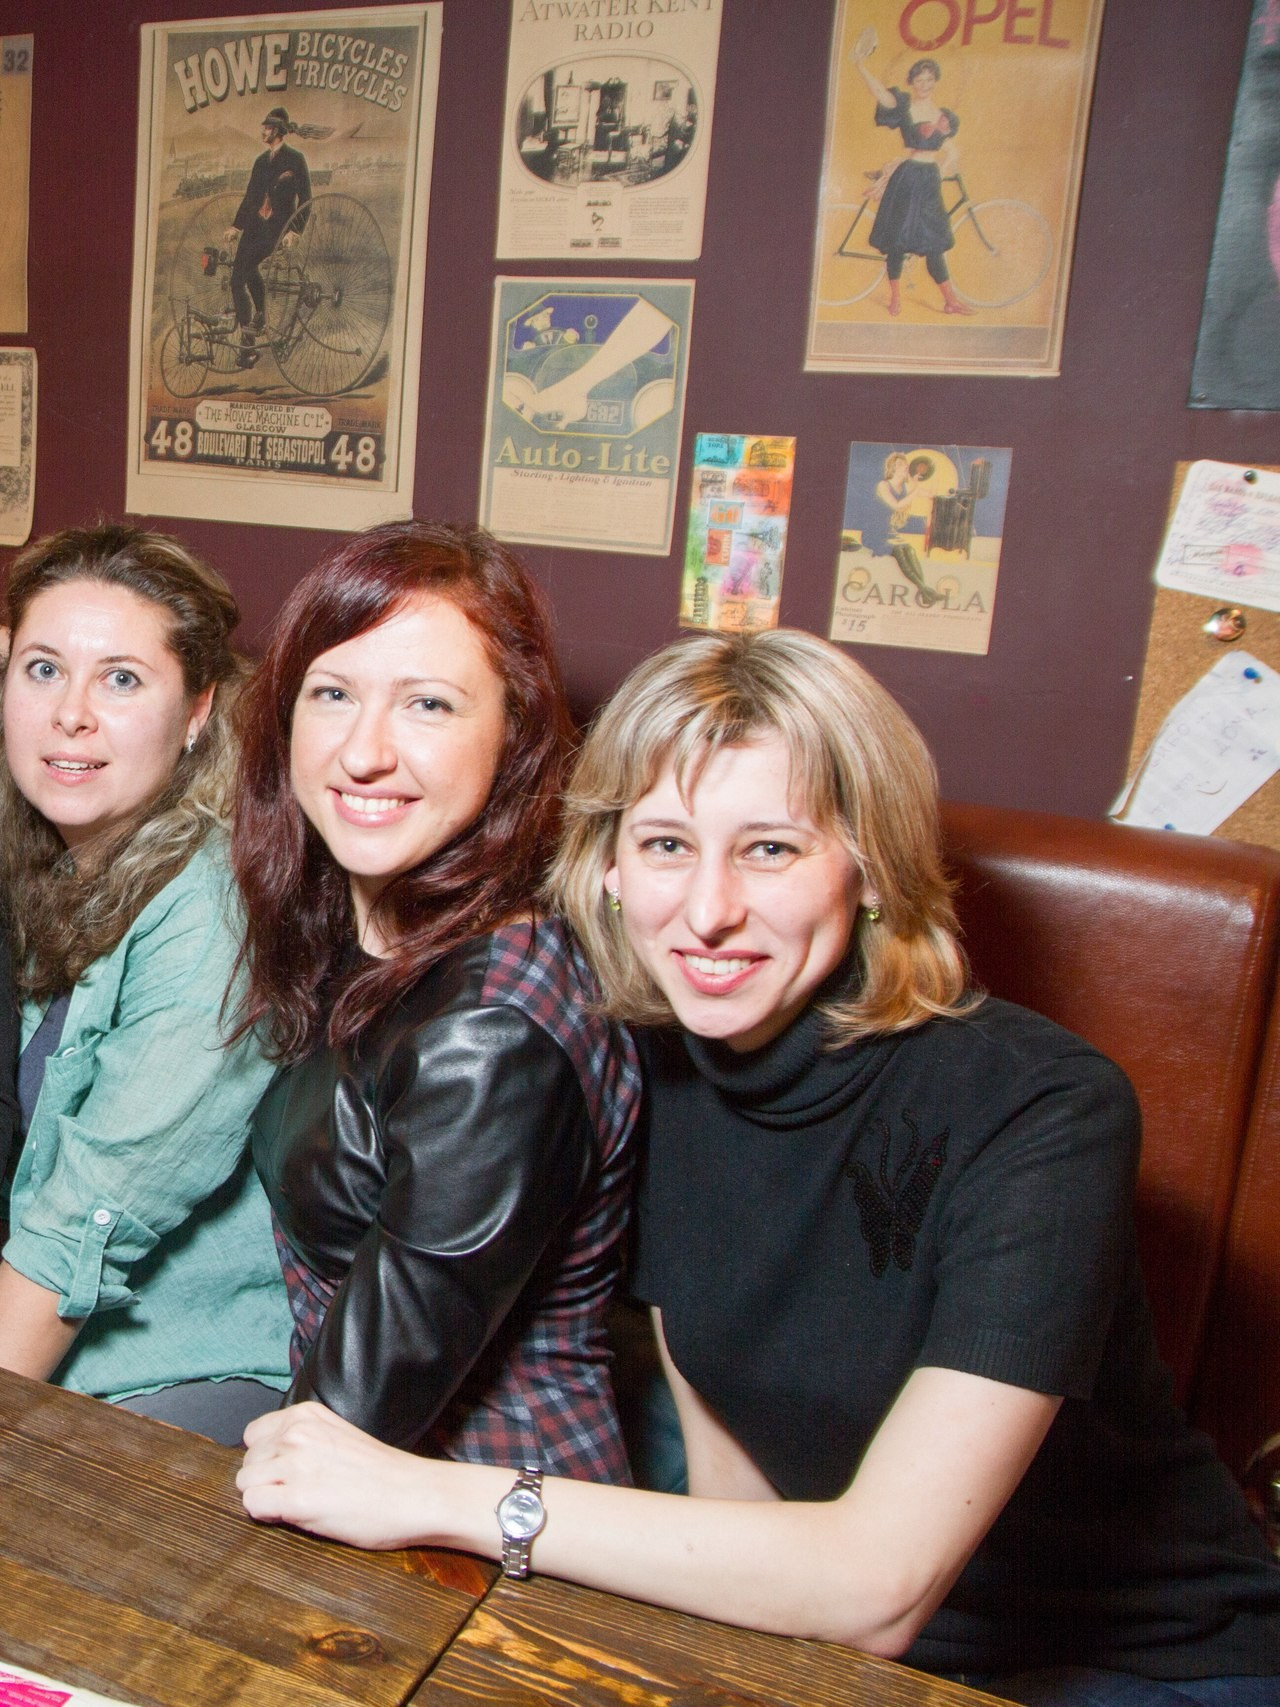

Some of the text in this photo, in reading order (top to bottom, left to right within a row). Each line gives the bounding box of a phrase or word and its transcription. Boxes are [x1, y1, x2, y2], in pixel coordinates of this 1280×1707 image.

[520, 0, 639, 22] ATWATER
[899, 0, 1070, 51] OPEL
[573, 20, 655, 42] RADIO
[4, 49, 30, 73] 32
[296, 31, 409, 79] BICYCLES
[173, 33, 291, 114] HOWE
[294, 60, 408, 112] TRICYCLES
[204, 406, 224, 422] THE
[224, 408, 253, 424] HOWE
[255, 410, 299, 427] MACHINE
[230, 402, 283, 412] MANUFACTURED
[151, 420, 194, 457] 48
[197, 431, 248, 459] BOULEVARD
[250, 436, 263, 460] DE
[331, 434, 377, 473] 48
[495, 436, 670, 474] Auto-Lite
[235, 457, 282, 469] PARIS
[559, 473, 600, 485] Lighting
[842, 580, 988, 614] CAROLA
